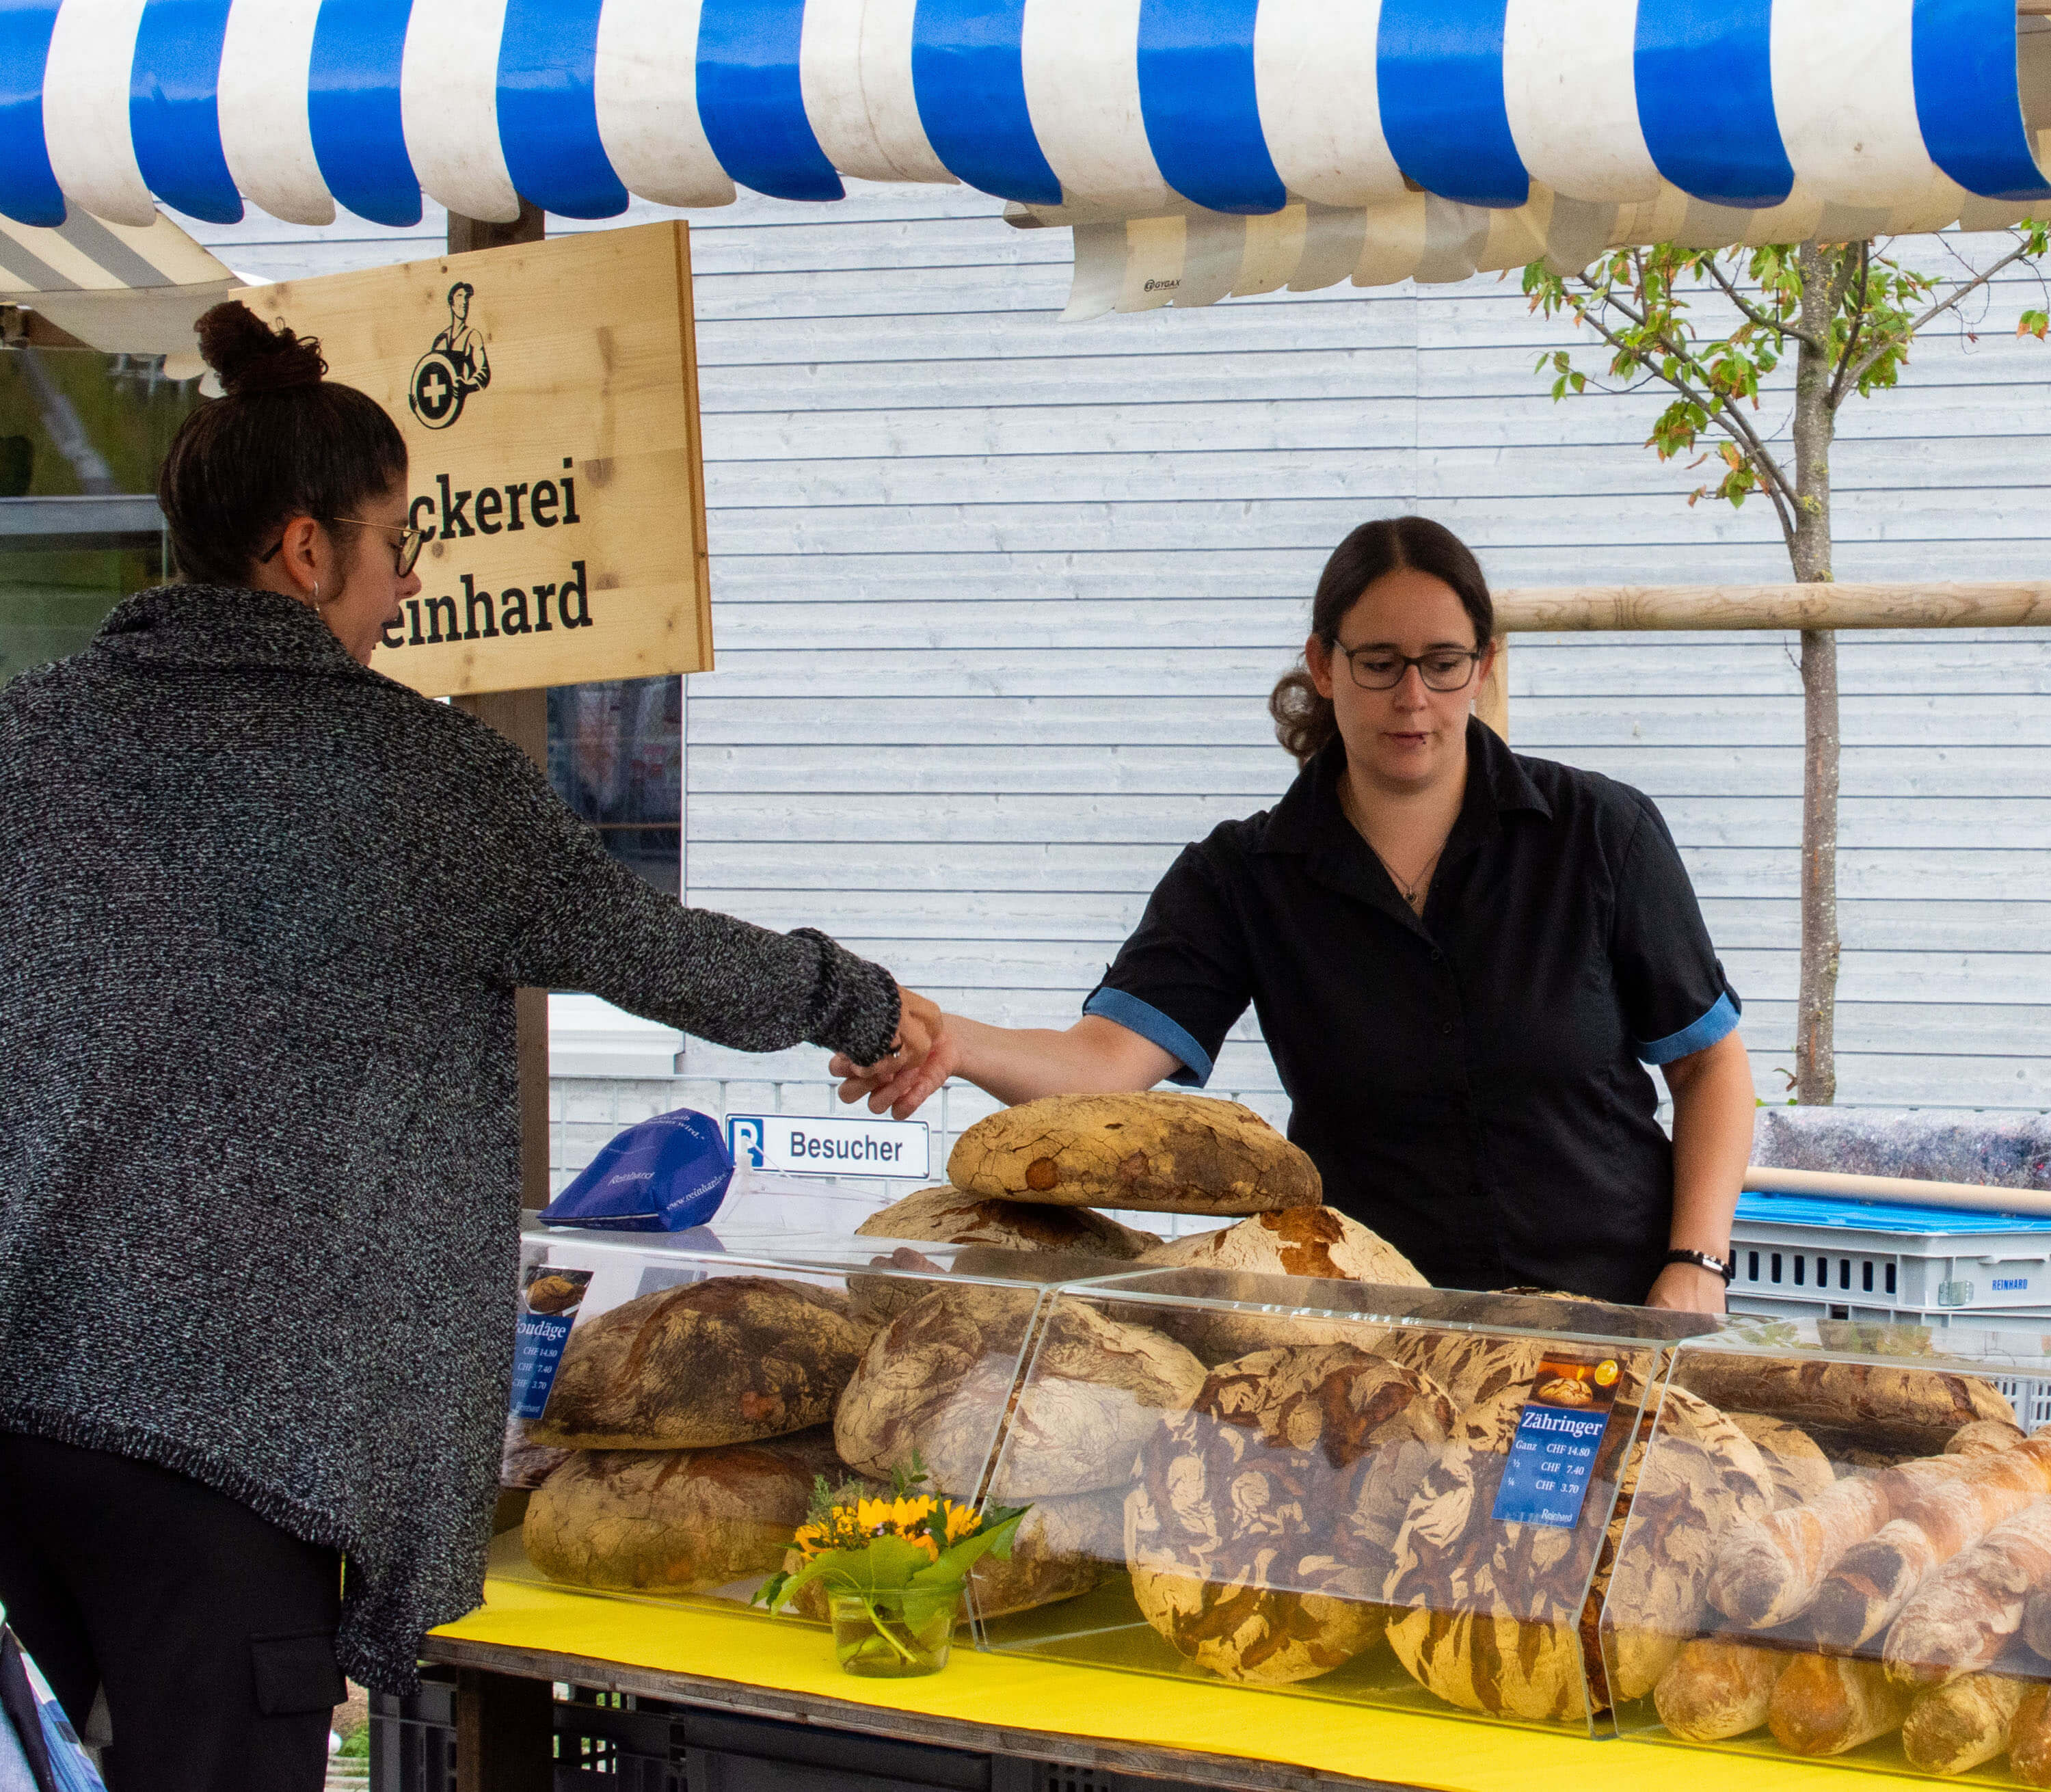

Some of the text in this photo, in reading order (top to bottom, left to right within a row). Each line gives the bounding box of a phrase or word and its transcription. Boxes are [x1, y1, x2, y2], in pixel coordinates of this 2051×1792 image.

[409, 457, 580, 543] ckerei
[371, 560, 593, 649] einhard
[790, 1131, 903, 1162] Besucher
[1992, 1279, 2028, 1291] REINHARD
[517, 1320, 566, 1341] oudäge
[523, 1346, 558, 1357] CHF 14.80
[518, 1362, 533, 1372] CHF
[531, 1381, 547, 1389] 3.70
[1521, 1412, 1603, 1437] Zähringer
[1515, 1440, 1590, 1457] Ganz CHF 14.80
[1540, 1462, 1561, 1473] CHF
[1566, 1465, 1585, 1475] 7.40
[1536, 1480, 1555, 1491] CHF
[1560, 1483, 1579, 1494] 3.70
